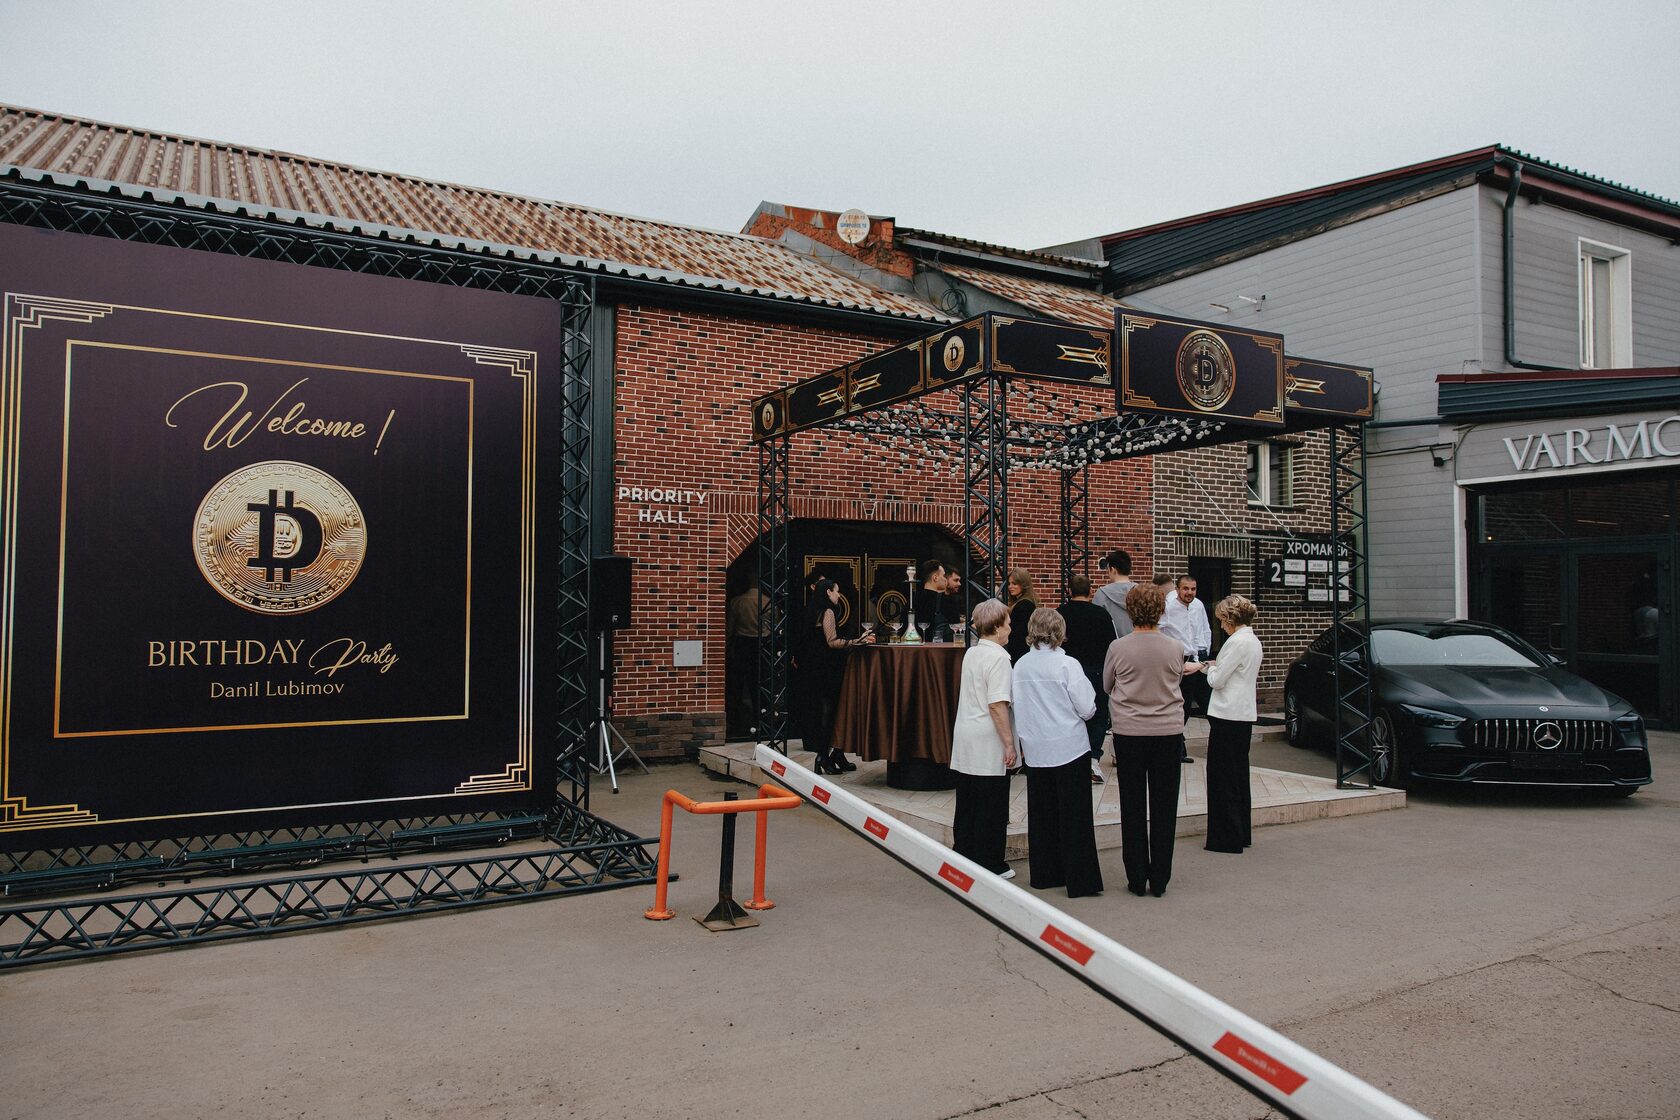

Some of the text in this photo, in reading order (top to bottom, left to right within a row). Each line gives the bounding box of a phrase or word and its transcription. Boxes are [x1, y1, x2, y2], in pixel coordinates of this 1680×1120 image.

[165, 377, 366, 452] Welcome
[618, 486, 709, 505] PRIORITY
[638, 508, 688, 524] HALL
[1271, 562, 1281, 583] 2
[148, 637, 400, 678] BIRTHDAY Party
[210, 681, 345, 699] Danil Lubimov
